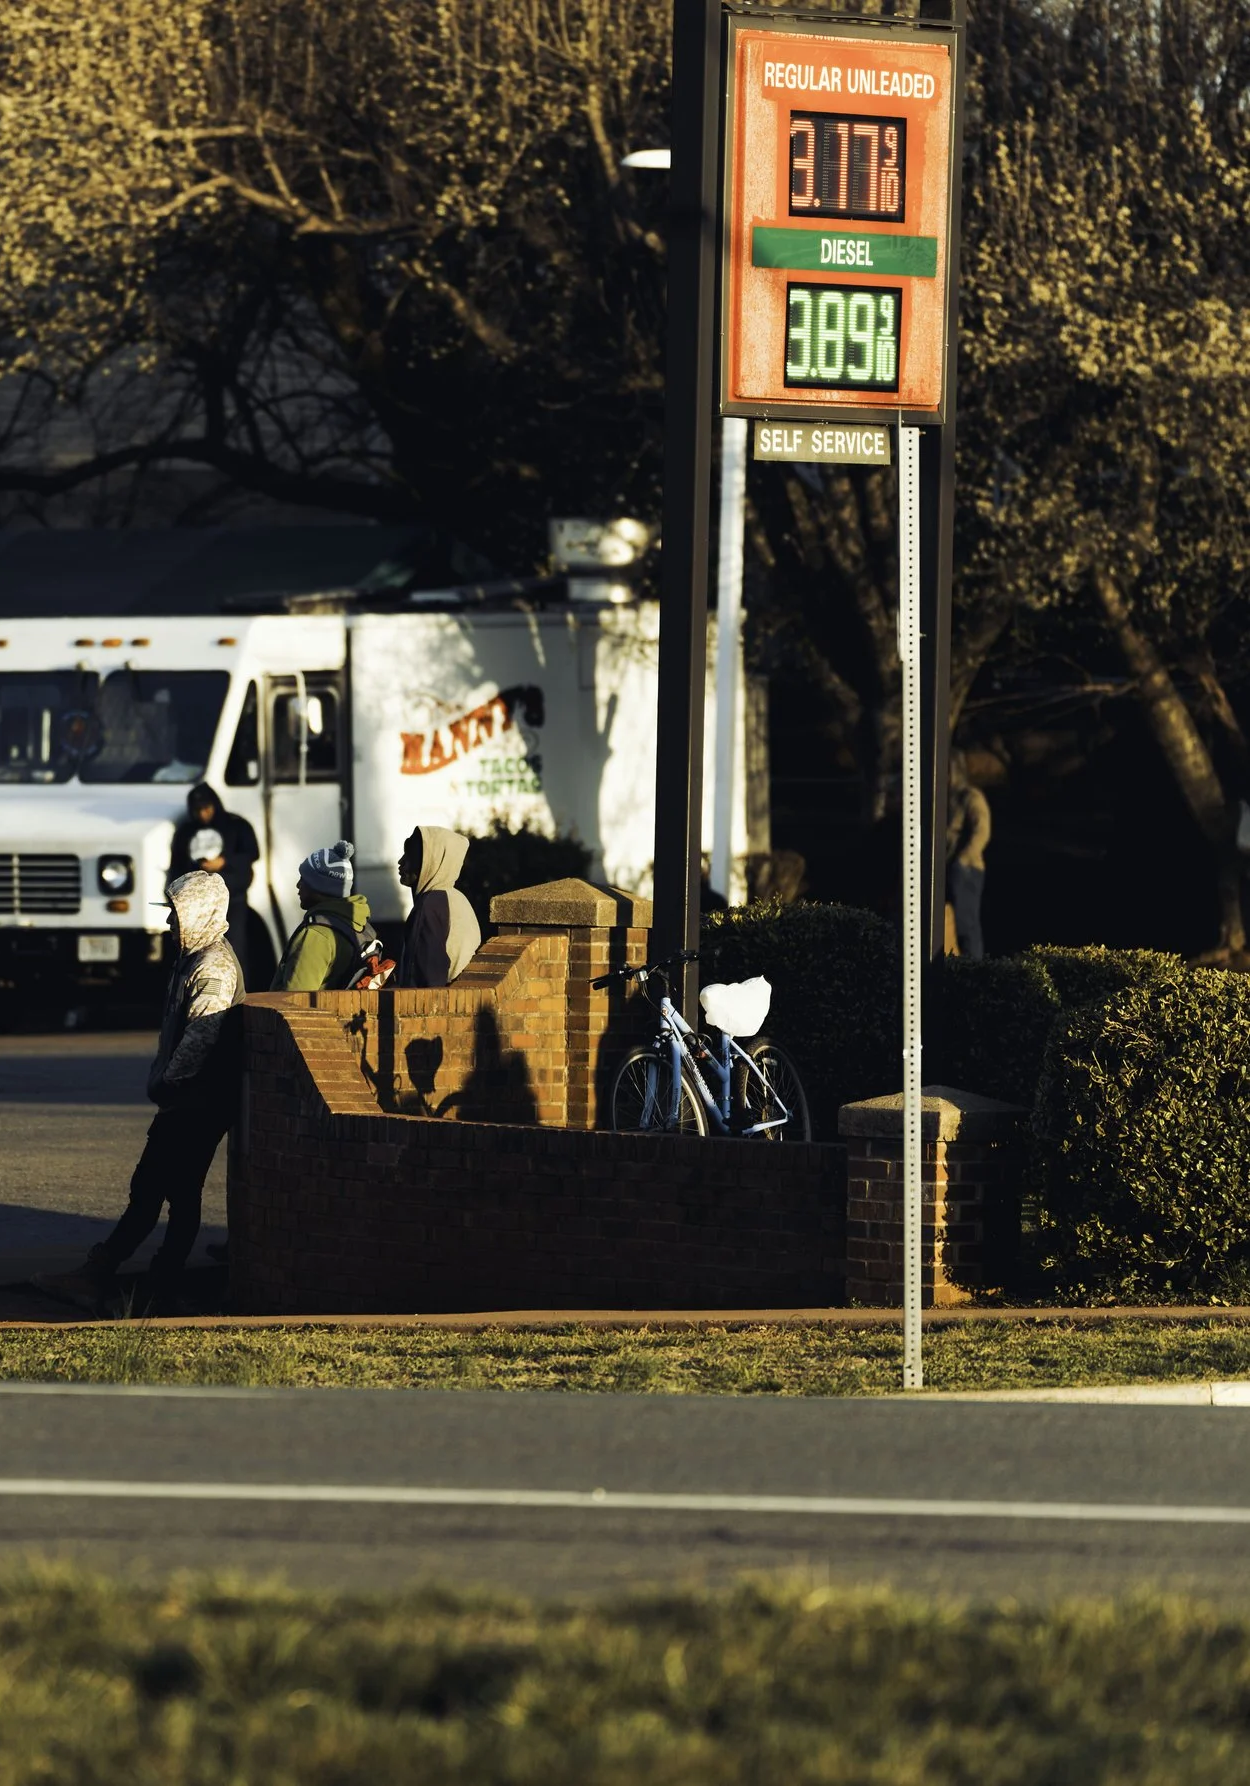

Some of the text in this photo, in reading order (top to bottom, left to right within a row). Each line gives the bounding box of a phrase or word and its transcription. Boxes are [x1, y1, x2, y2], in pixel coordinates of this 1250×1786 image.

[764, 62, 935, 99] REGULAR UNLEADED
[820, 239, 874, 266] DIESEL
[760, 428, 885, 456] SELF SERVICE
